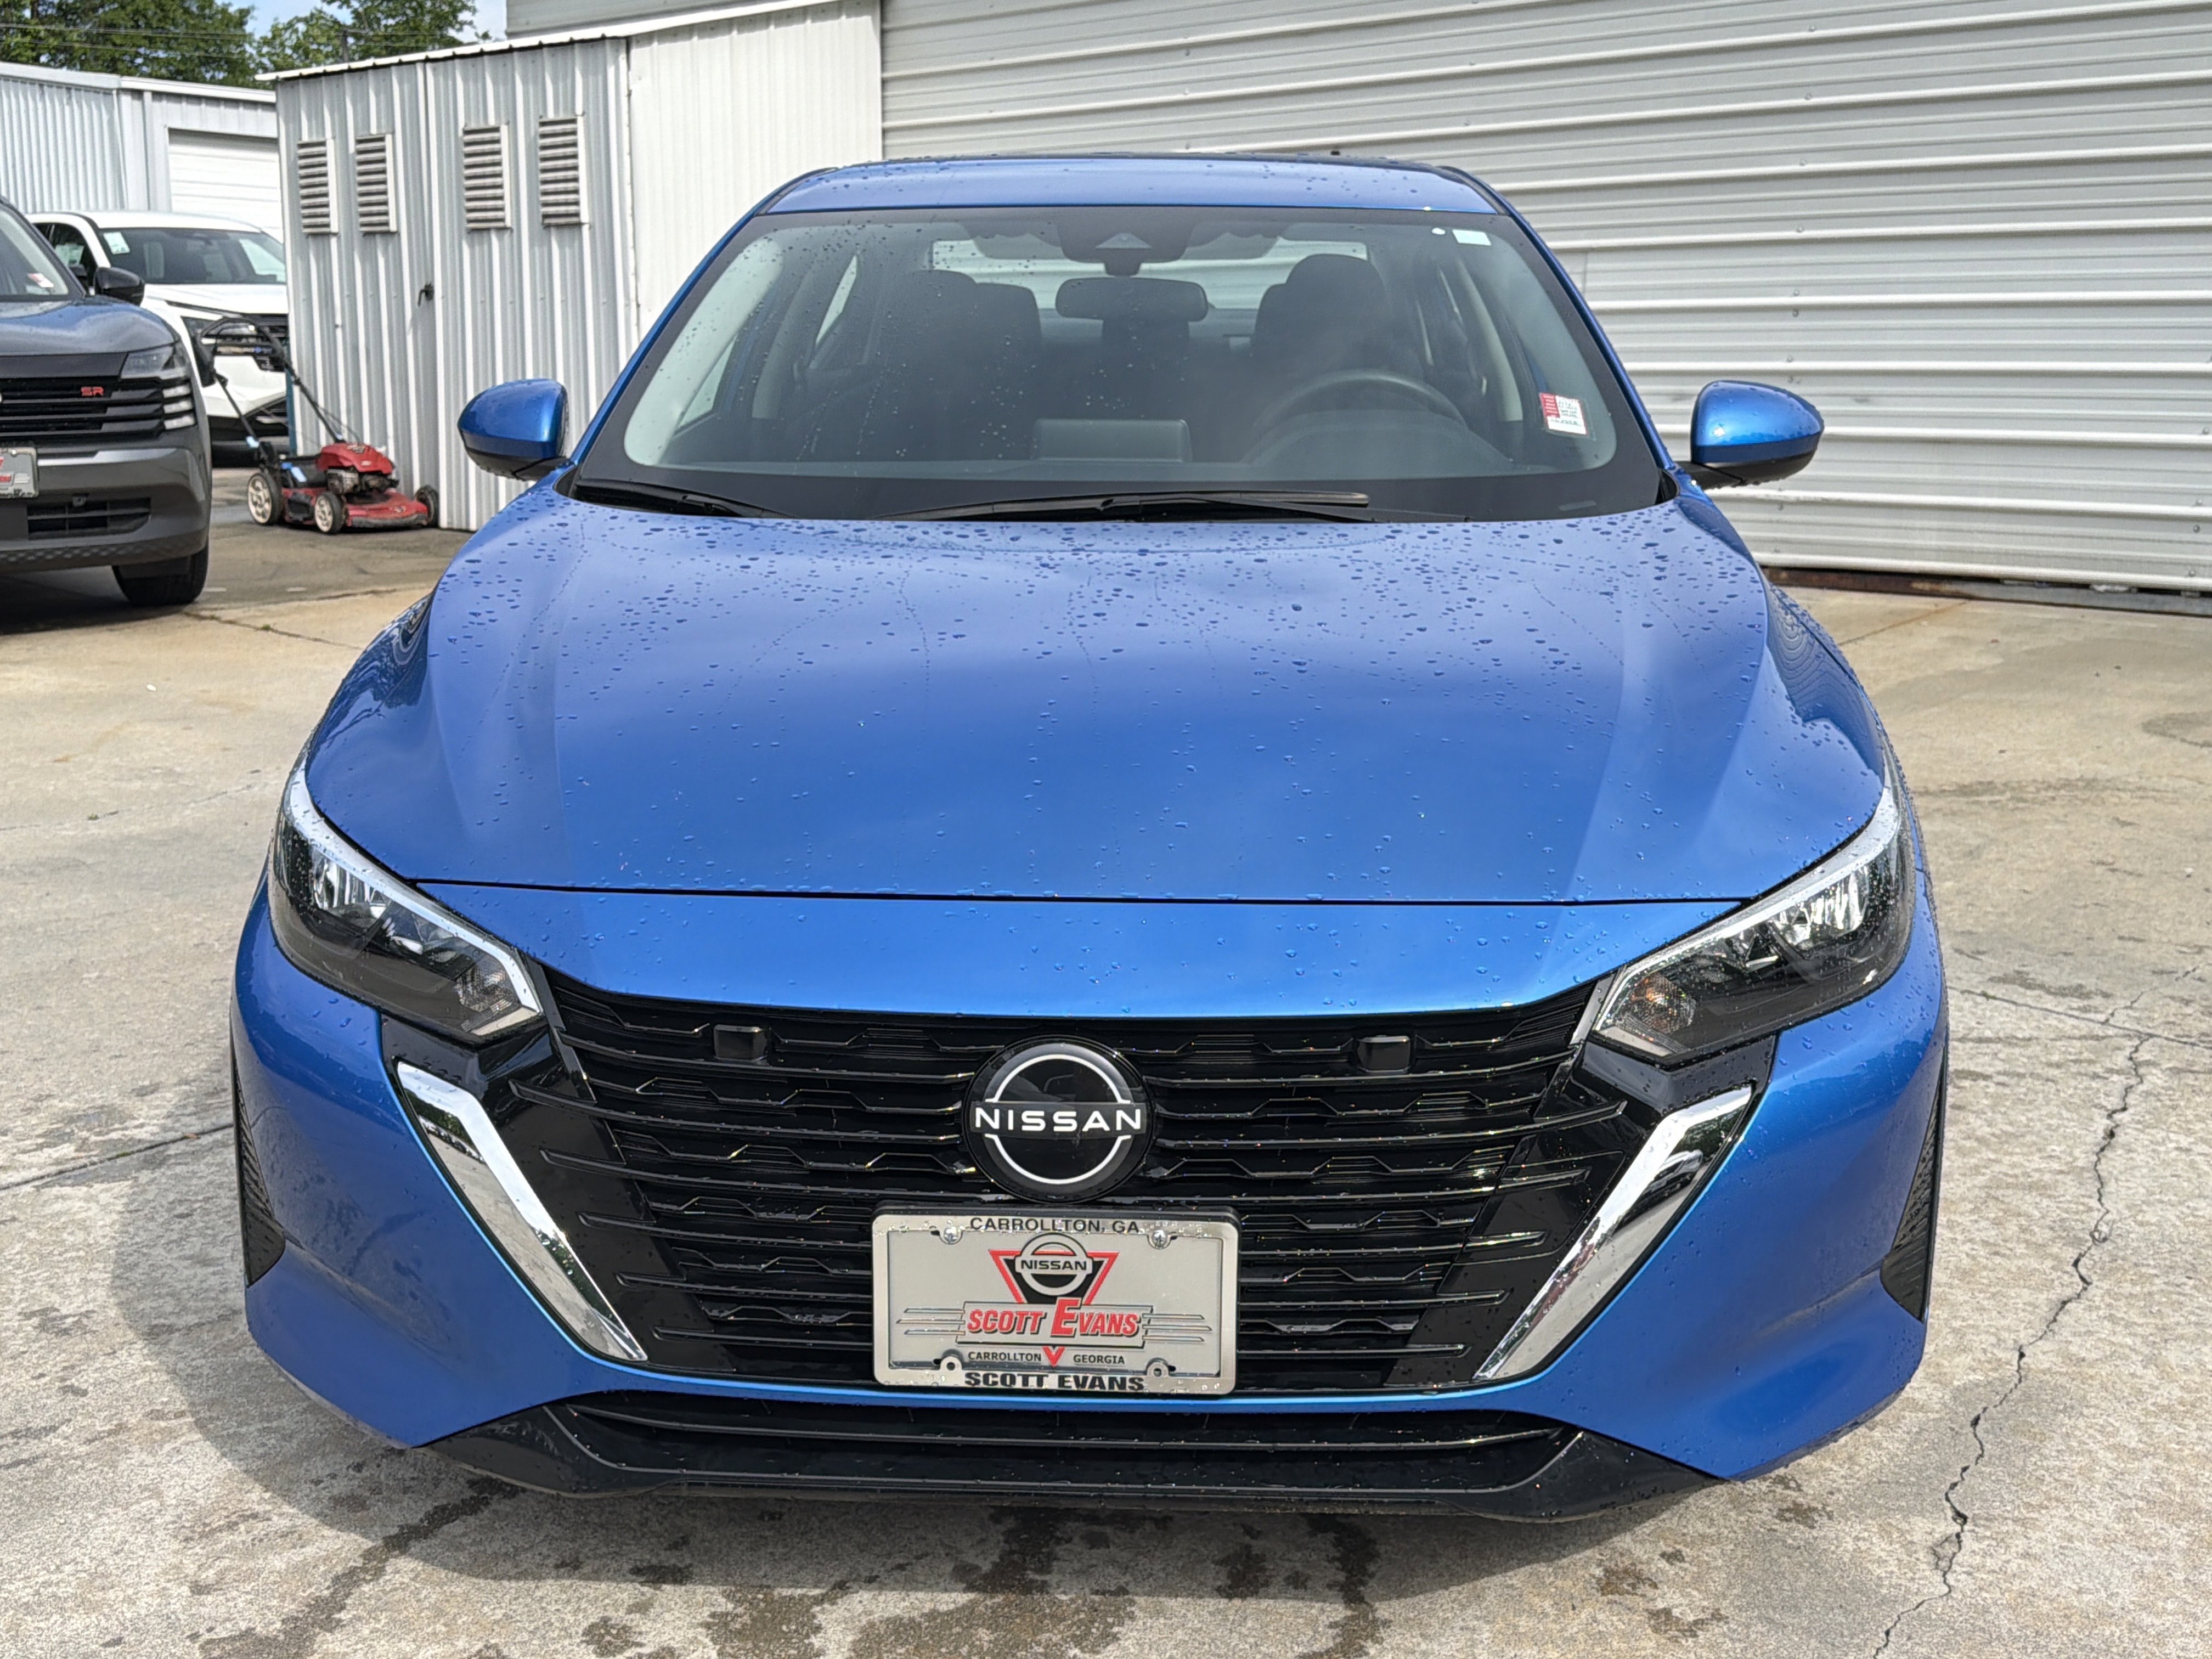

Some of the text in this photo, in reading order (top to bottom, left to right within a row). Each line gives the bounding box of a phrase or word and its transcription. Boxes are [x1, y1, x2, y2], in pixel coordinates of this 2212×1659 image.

[81, 386, 104, 397] SR
[975, 1107, 1141, 1132] NISSAN
[970, 1217, 1139, 1233] CARROLLTON, GA
[1020, 1259, 1087, 1271] NISSAN
[967, 1297, 1141, 1338] SCOTT EVANS
[968, 1351, 1125, 1364] CARROLLTON GEORGIA
[964, 1372, 1145, 1391] SCOTT EVANS
